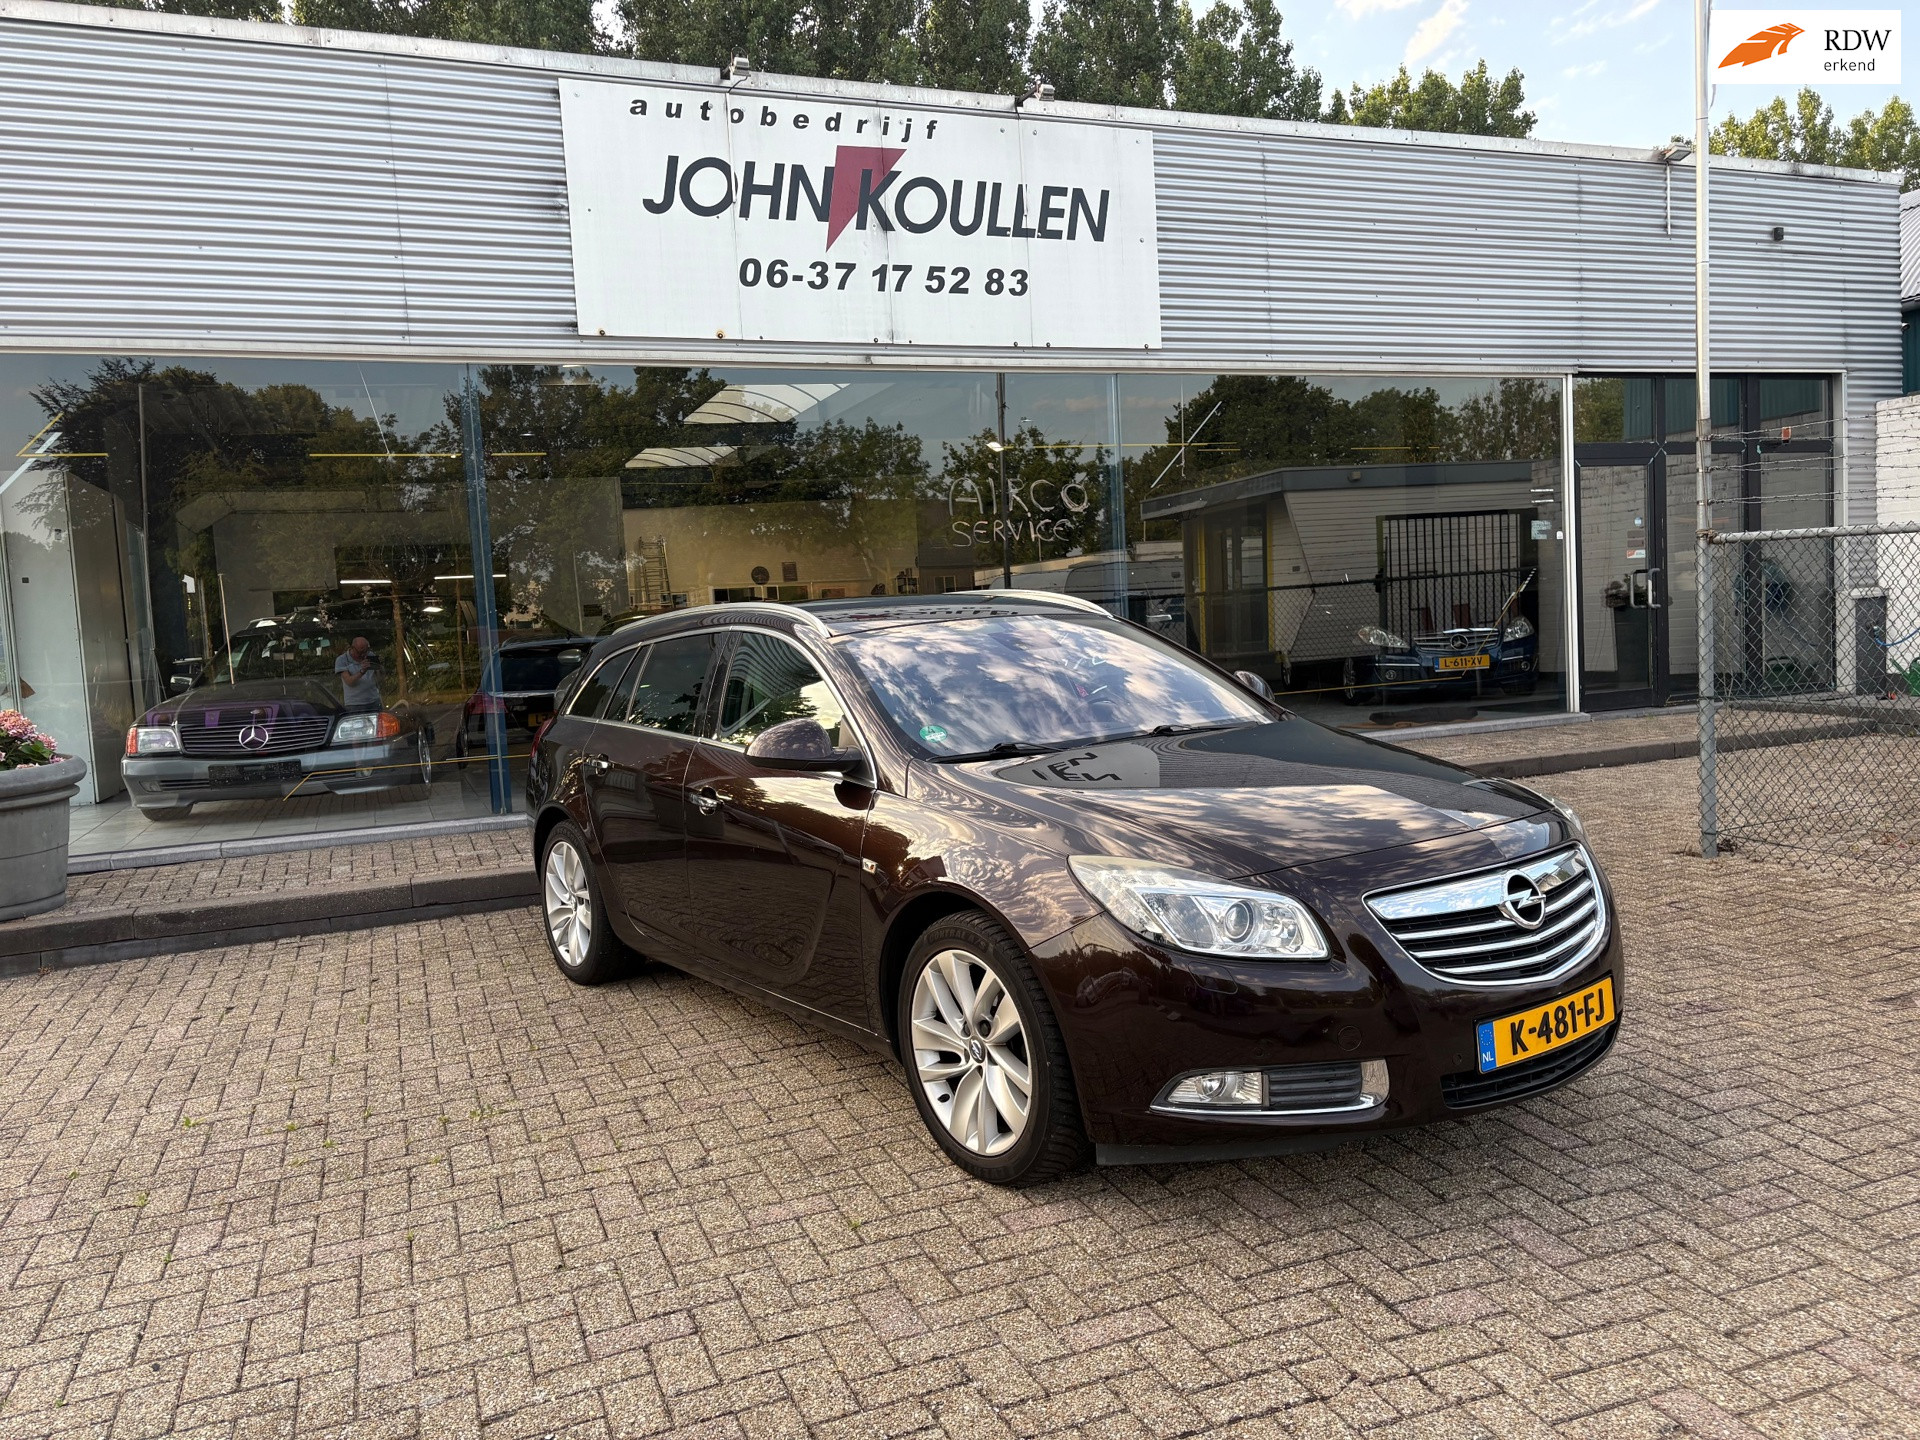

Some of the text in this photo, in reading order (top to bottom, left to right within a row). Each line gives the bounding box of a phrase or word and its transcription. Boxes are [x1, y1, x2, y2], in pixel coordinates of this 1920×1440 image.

[628, 97, 938, 143] autobedrijf
[642, 154, 1110, 243] JOHN KOULLEN
[738, 257, 1030, 297] 06-37 17 52 83
[1444, 656, 1483, 668] L-611-XV
[1510, 988, 1606, 1056] K-481-FJ
[1482, 1051, 1495, 1064] NL
